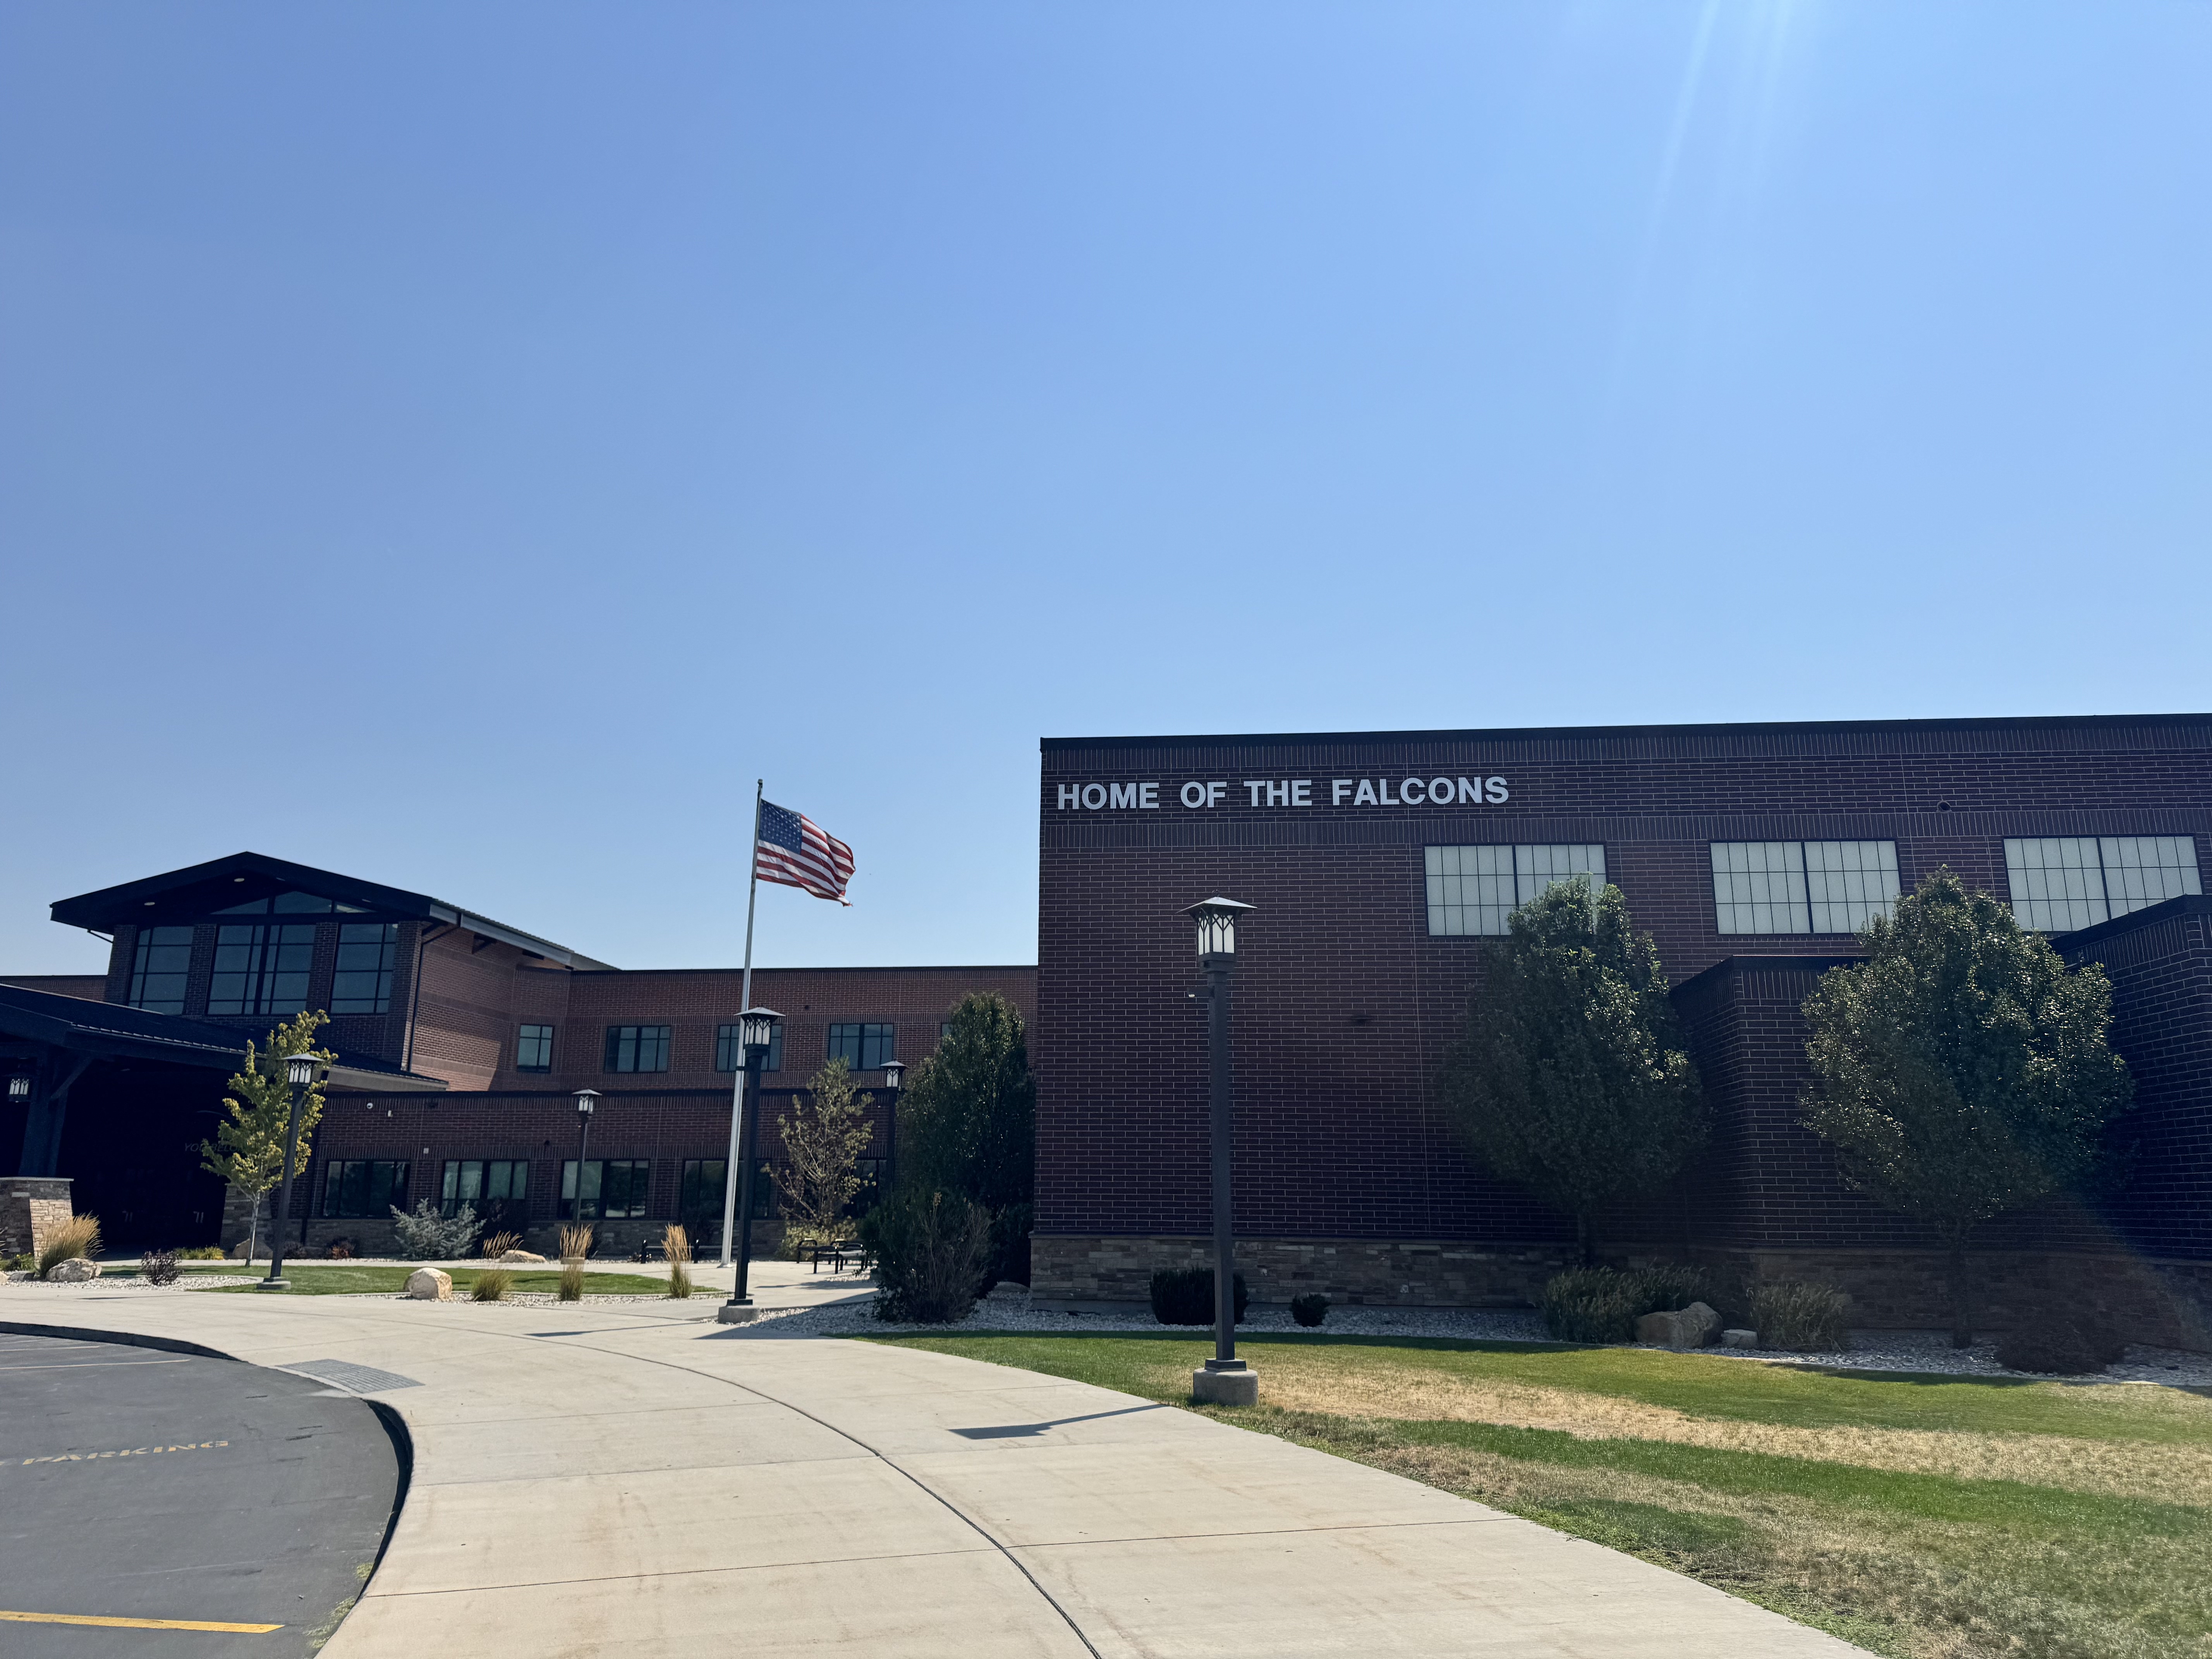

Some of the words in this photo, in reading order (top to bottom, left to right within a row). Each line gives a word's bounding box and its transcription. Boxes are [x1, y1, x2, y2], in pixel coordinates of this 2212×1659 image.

[1058, 782, 1159, 810] HOME
[1180, 781, 1227, 808] OF
[1243, 780, 1312, 807] THE
[1332, 776, 1509, 805] FALCONS
[22, 1441, 228, 1465] PARKING
